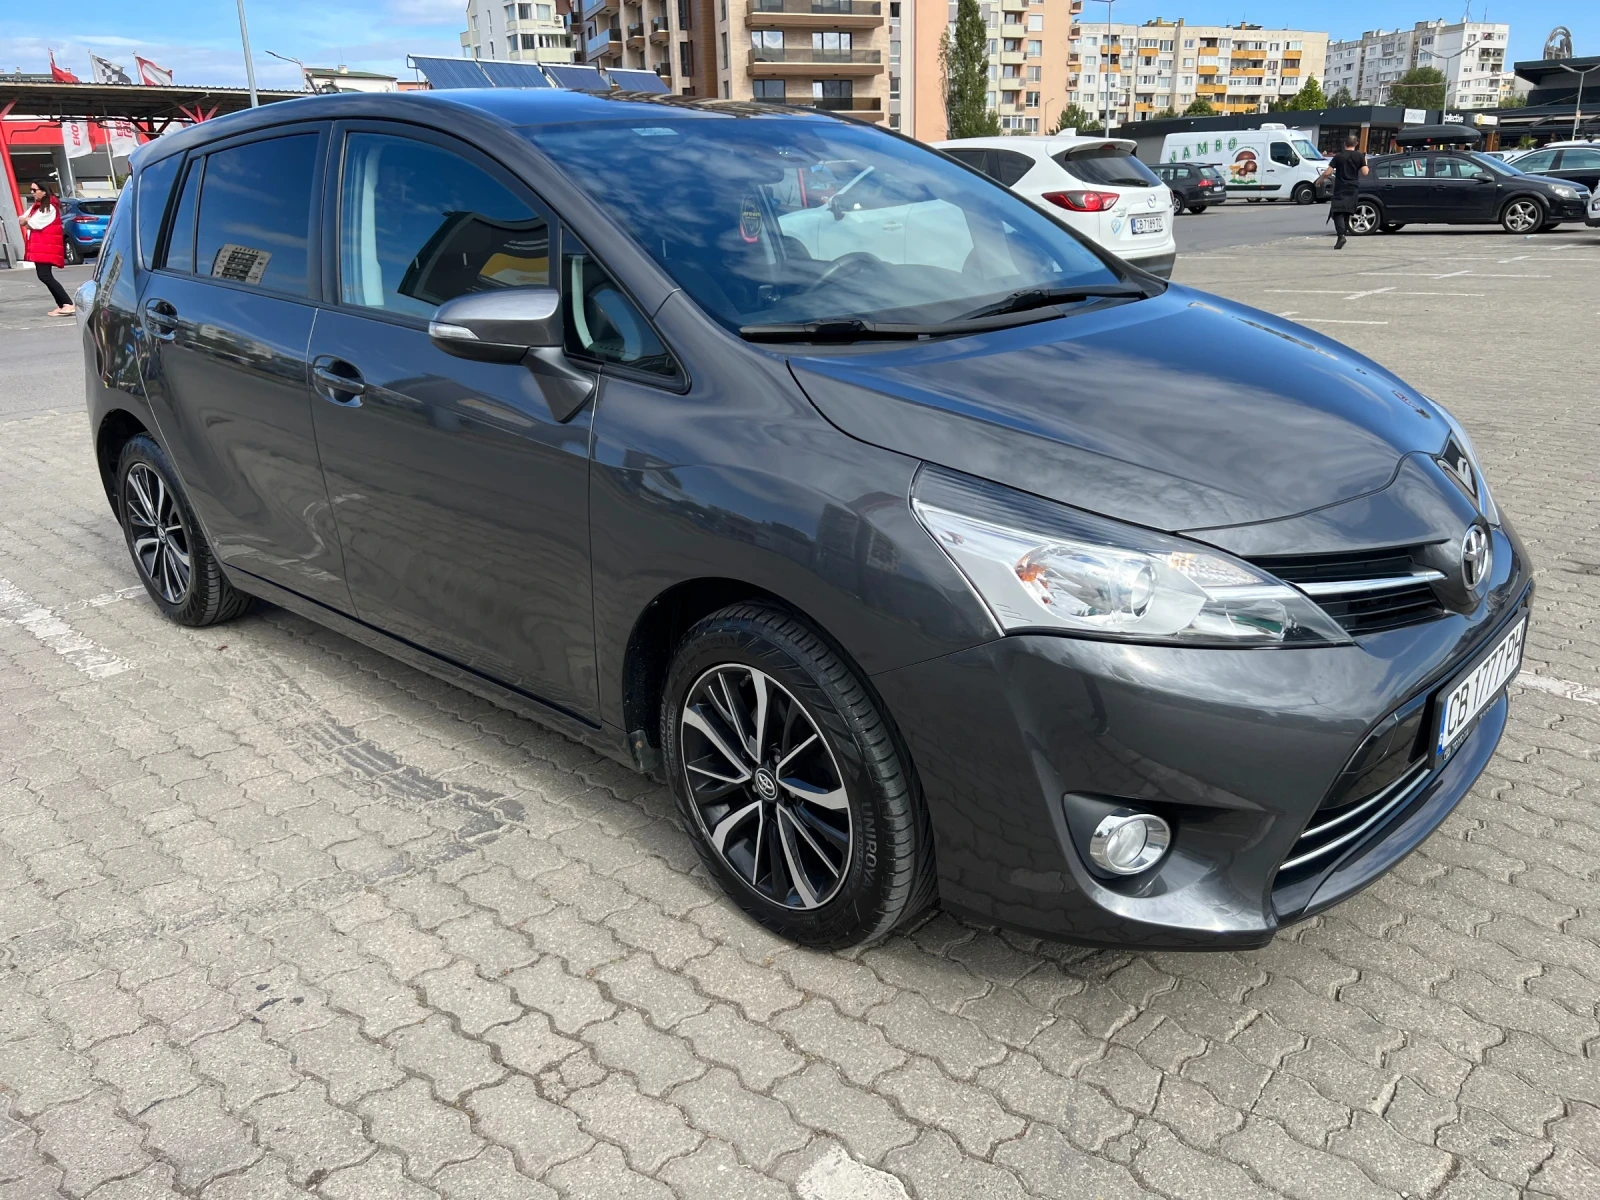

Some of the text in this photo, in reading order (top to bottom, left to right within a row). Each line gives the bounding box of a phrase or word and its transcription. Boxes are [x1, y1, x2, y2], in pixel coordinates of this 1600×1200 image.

[1169, 137, 1237, 164] JAMBO
[1448, 683, 1469, 736] CB
[1474, 645, 1506, 710] 1777
